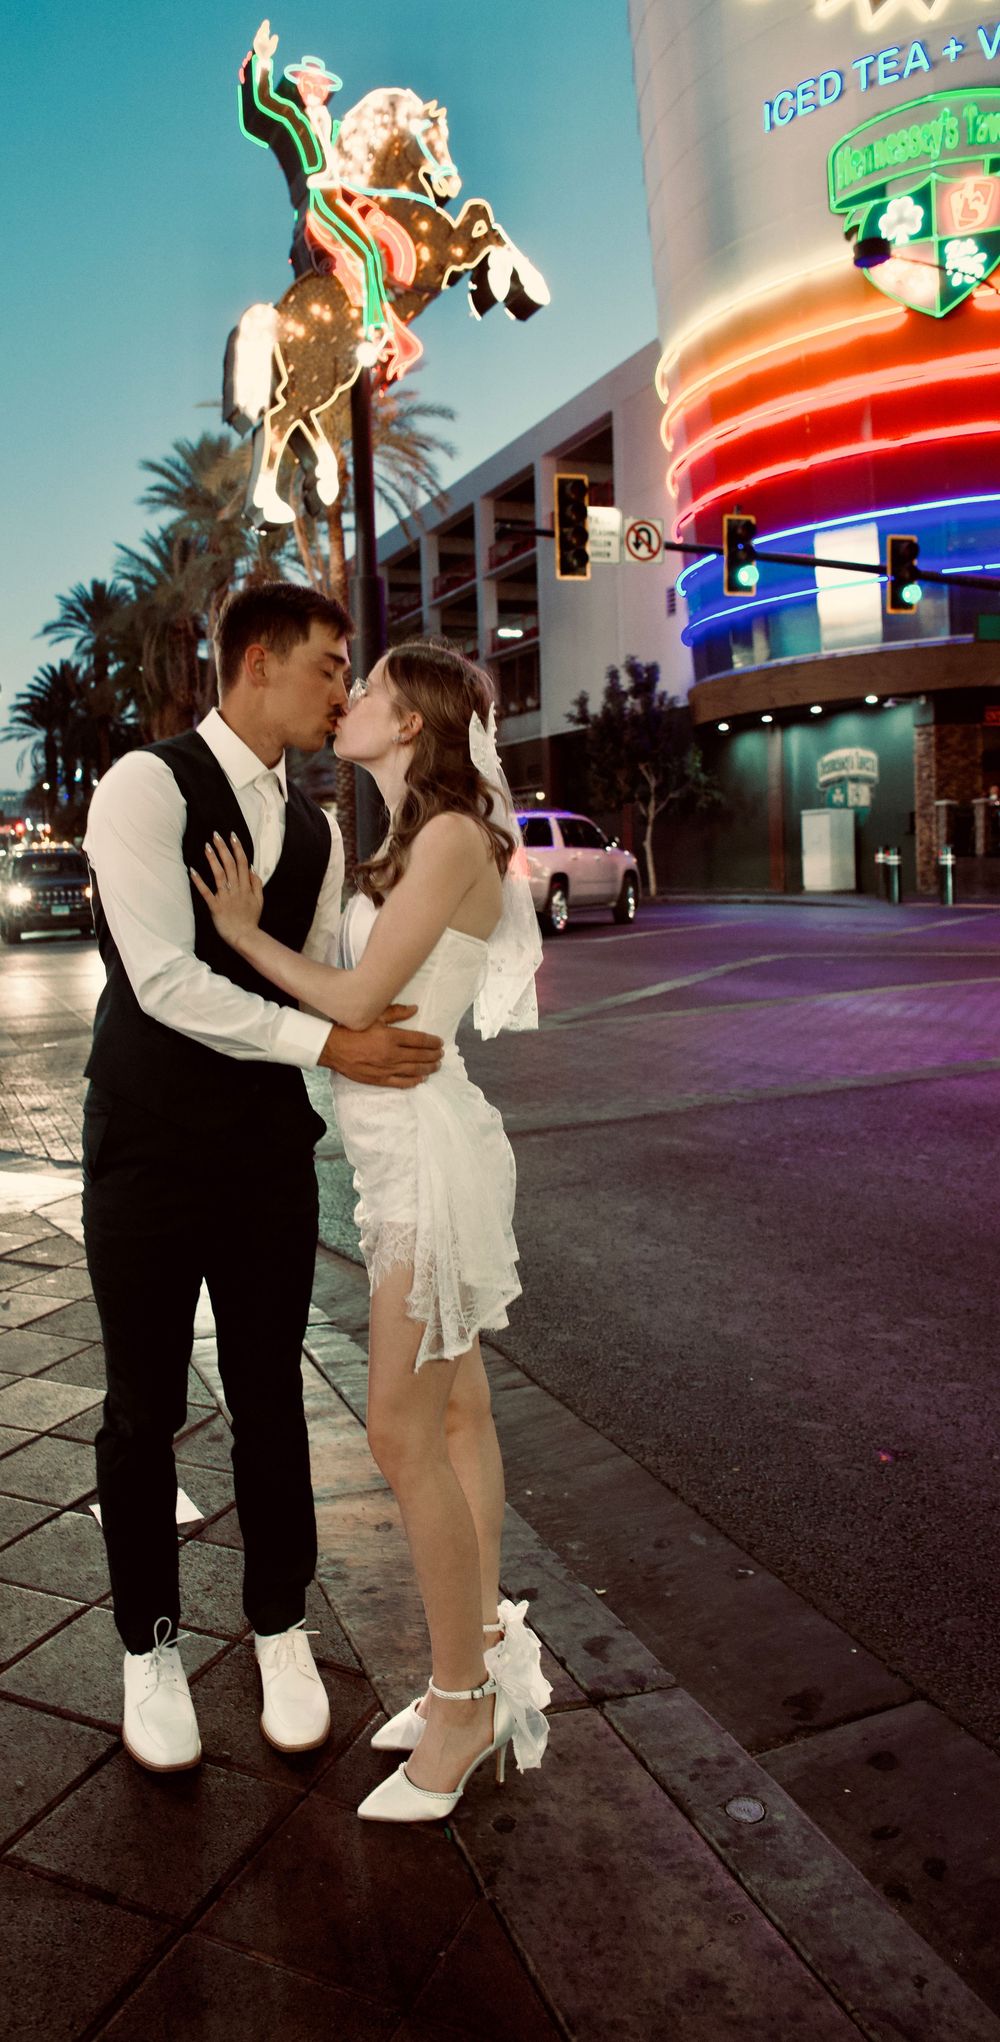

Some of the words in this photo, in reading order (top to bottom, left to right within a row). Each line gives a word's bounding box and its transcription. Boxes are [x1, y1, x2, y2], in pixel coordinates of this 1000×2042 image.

[763, 69, 843, 134] ICED
[851, 40, 932, 92] TEA
[942, 37, 964, 62] +
